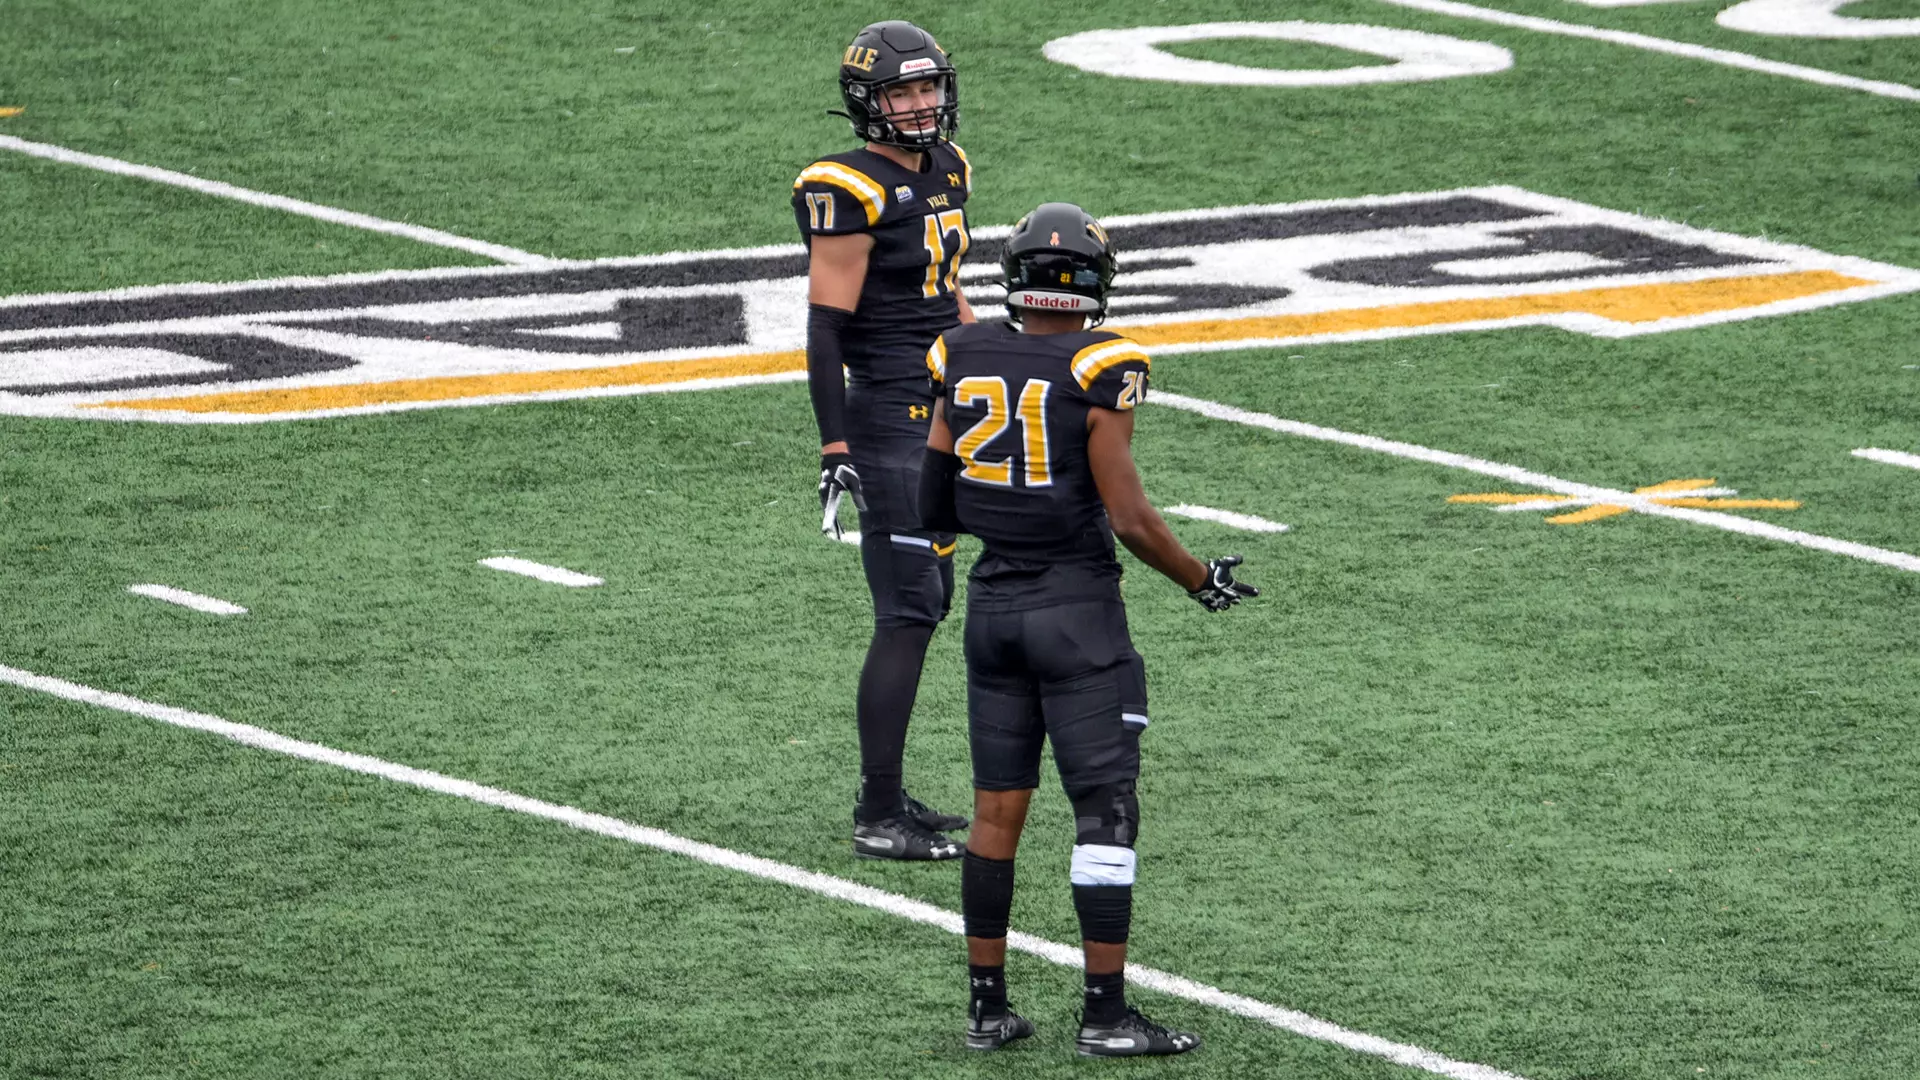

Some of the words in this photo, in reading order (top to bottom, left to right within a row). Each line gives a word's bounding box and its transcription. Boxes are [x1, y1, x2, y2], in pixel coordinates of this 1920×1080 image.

[843, 45, 878, 72] ILLE
[805, 192, 834, 229] 17
[926, 193, 950, 209] VILLE
[922, 208, 969, 298] 17
[1060, 273, 1071, 283] 21
[1023, 294, 1081, 308] Riddell
[1115, 371, 1144, 409] 21
[953, 376, 1054, 487] 21
